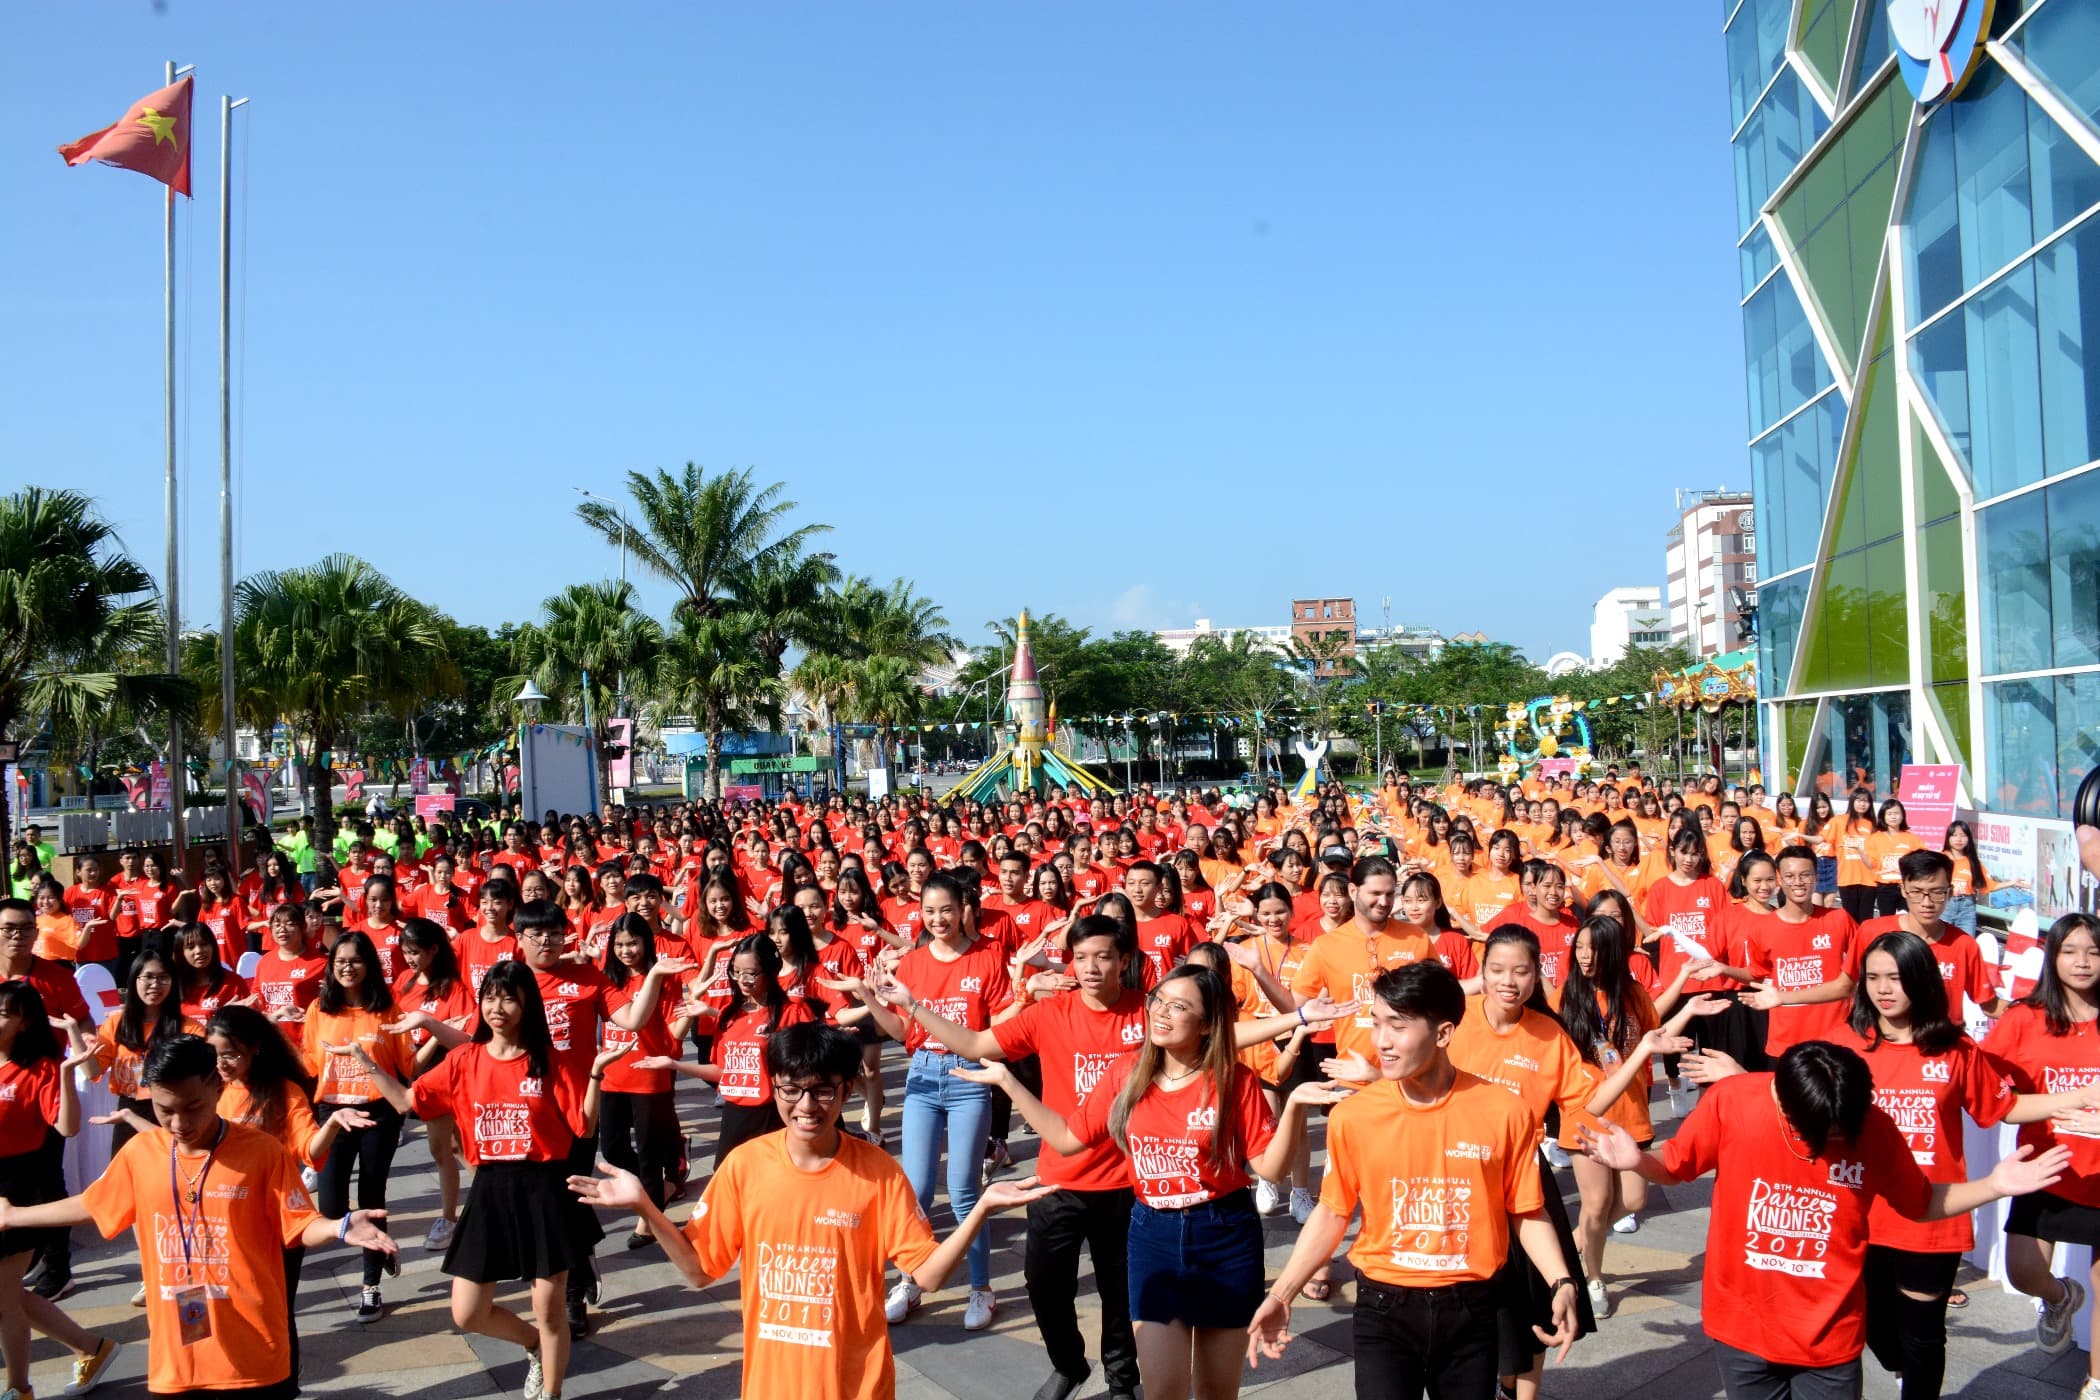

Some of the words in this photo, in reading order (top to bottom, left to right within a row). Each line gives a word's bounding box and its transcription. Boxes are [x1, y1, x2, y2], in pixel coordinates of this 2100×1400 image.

[1154, 934, 1171, 946] dkt
[1812, 933, 1832, 947] dkt
[1776, 956, 1814, 971] Dance
[960, 976, 981, 989] dkt
[1777, 967, 1823, 987] KINDNESS
[558, 982, 579, 994] dkt
[1121, 1023, 1144, 1041] dkt
[726, 1055, 760, 1069] NDNESS
[1073, 1052, 1113, 1072] Dan
[1922, 1060, 1950, 1078] dkt
[519, 1077, 543, 1094] dkt
[473, 1101, 520, 1120] Dance
[1187, 1106, 1216, 1126] dkt
[1888, 1108, 1936, 1128] DNESS
[474, 1116, 532, 1142] KINDNESS
[477, 1139, 532, 1155] 2019
[1129, 1132, 1187, 1159] Dance
[1143, 1135, 1160, 1143] 8TH
[1163, 1137, 1199, 1145] ANNUAL
[1905, 1134, 1935, 1150] 19
[1445, 1149, 1481, 1159] WOMEN
[1133, 1152, 1201, 1180] KINDNESS
[1828, 1159, 1865, 1185] dkt
[1389, 1176, 1456, 1204] Dance
[1751, 1177, 1821, 1212] Dance
[1774, 1182, 1792, 1191] 8TH
[1795, 1186, 1838, 1202] ANNUAL
[813, 1215, 851, 1227] WOMEN
[1391, 1198, 1471, 1230] KINDNESS
[1746, 1201, 1833, 1234] KINDNESS
[776, 1243, 795, 1253] 8TH
[797, 1244, 839, 1255] ANNUAL
[1391, 1231, 1468, 1251] 2019
[1745, 1230, 1828, 1258] 2019
[757, 1241, 821, 1273] Dance
[1407, 1256, 1431, 1268] NOV.
[1761, 1257, 1787, 1270] NOV.
[758, 1265, 835, 1298] KINDNESS
[760, 1299, 833, 1326] 2019
[771, 1328, 794, 1340] NOV.
